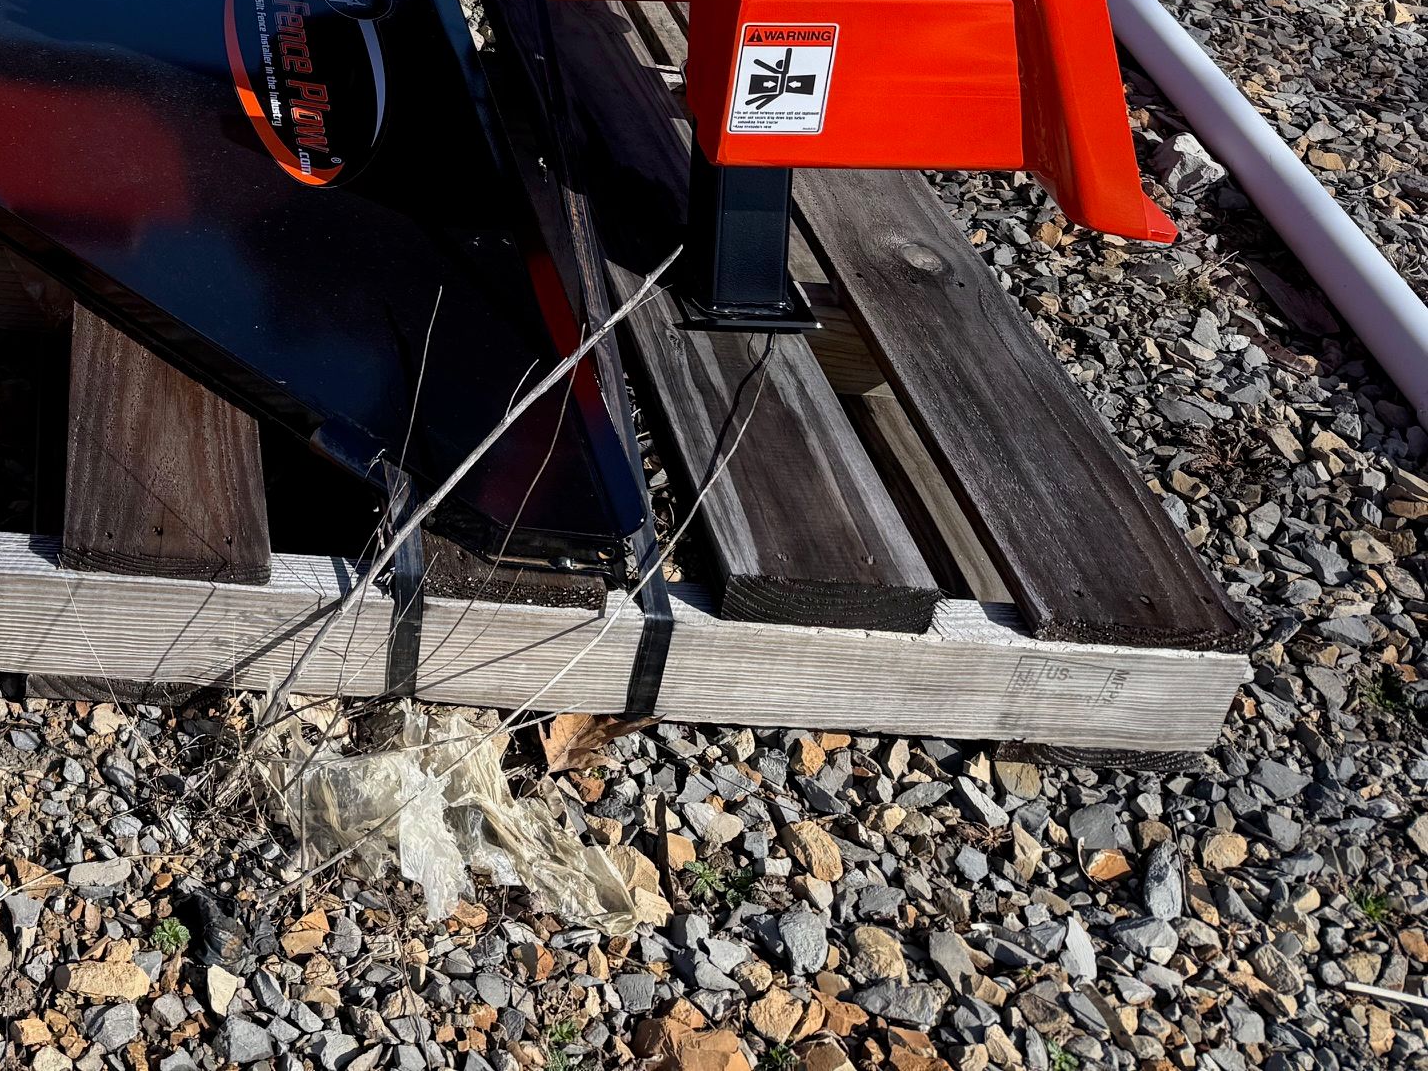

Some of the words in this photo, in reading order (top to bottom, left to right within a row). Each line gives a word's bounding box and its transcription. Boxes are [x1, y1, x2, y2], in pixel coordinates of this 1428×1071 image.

[257, 11, 267, 32] Fence
[763, 30, 832, 42] WARNING
[260, 33, 273, 65] Installer
[265, 66, 275, 74] in
[267, 75, 278, 90] the
[269, 91, 283, 126] Industry
[286, 79, 330, 153] Plow
[298, 148, 312, 175] .com
